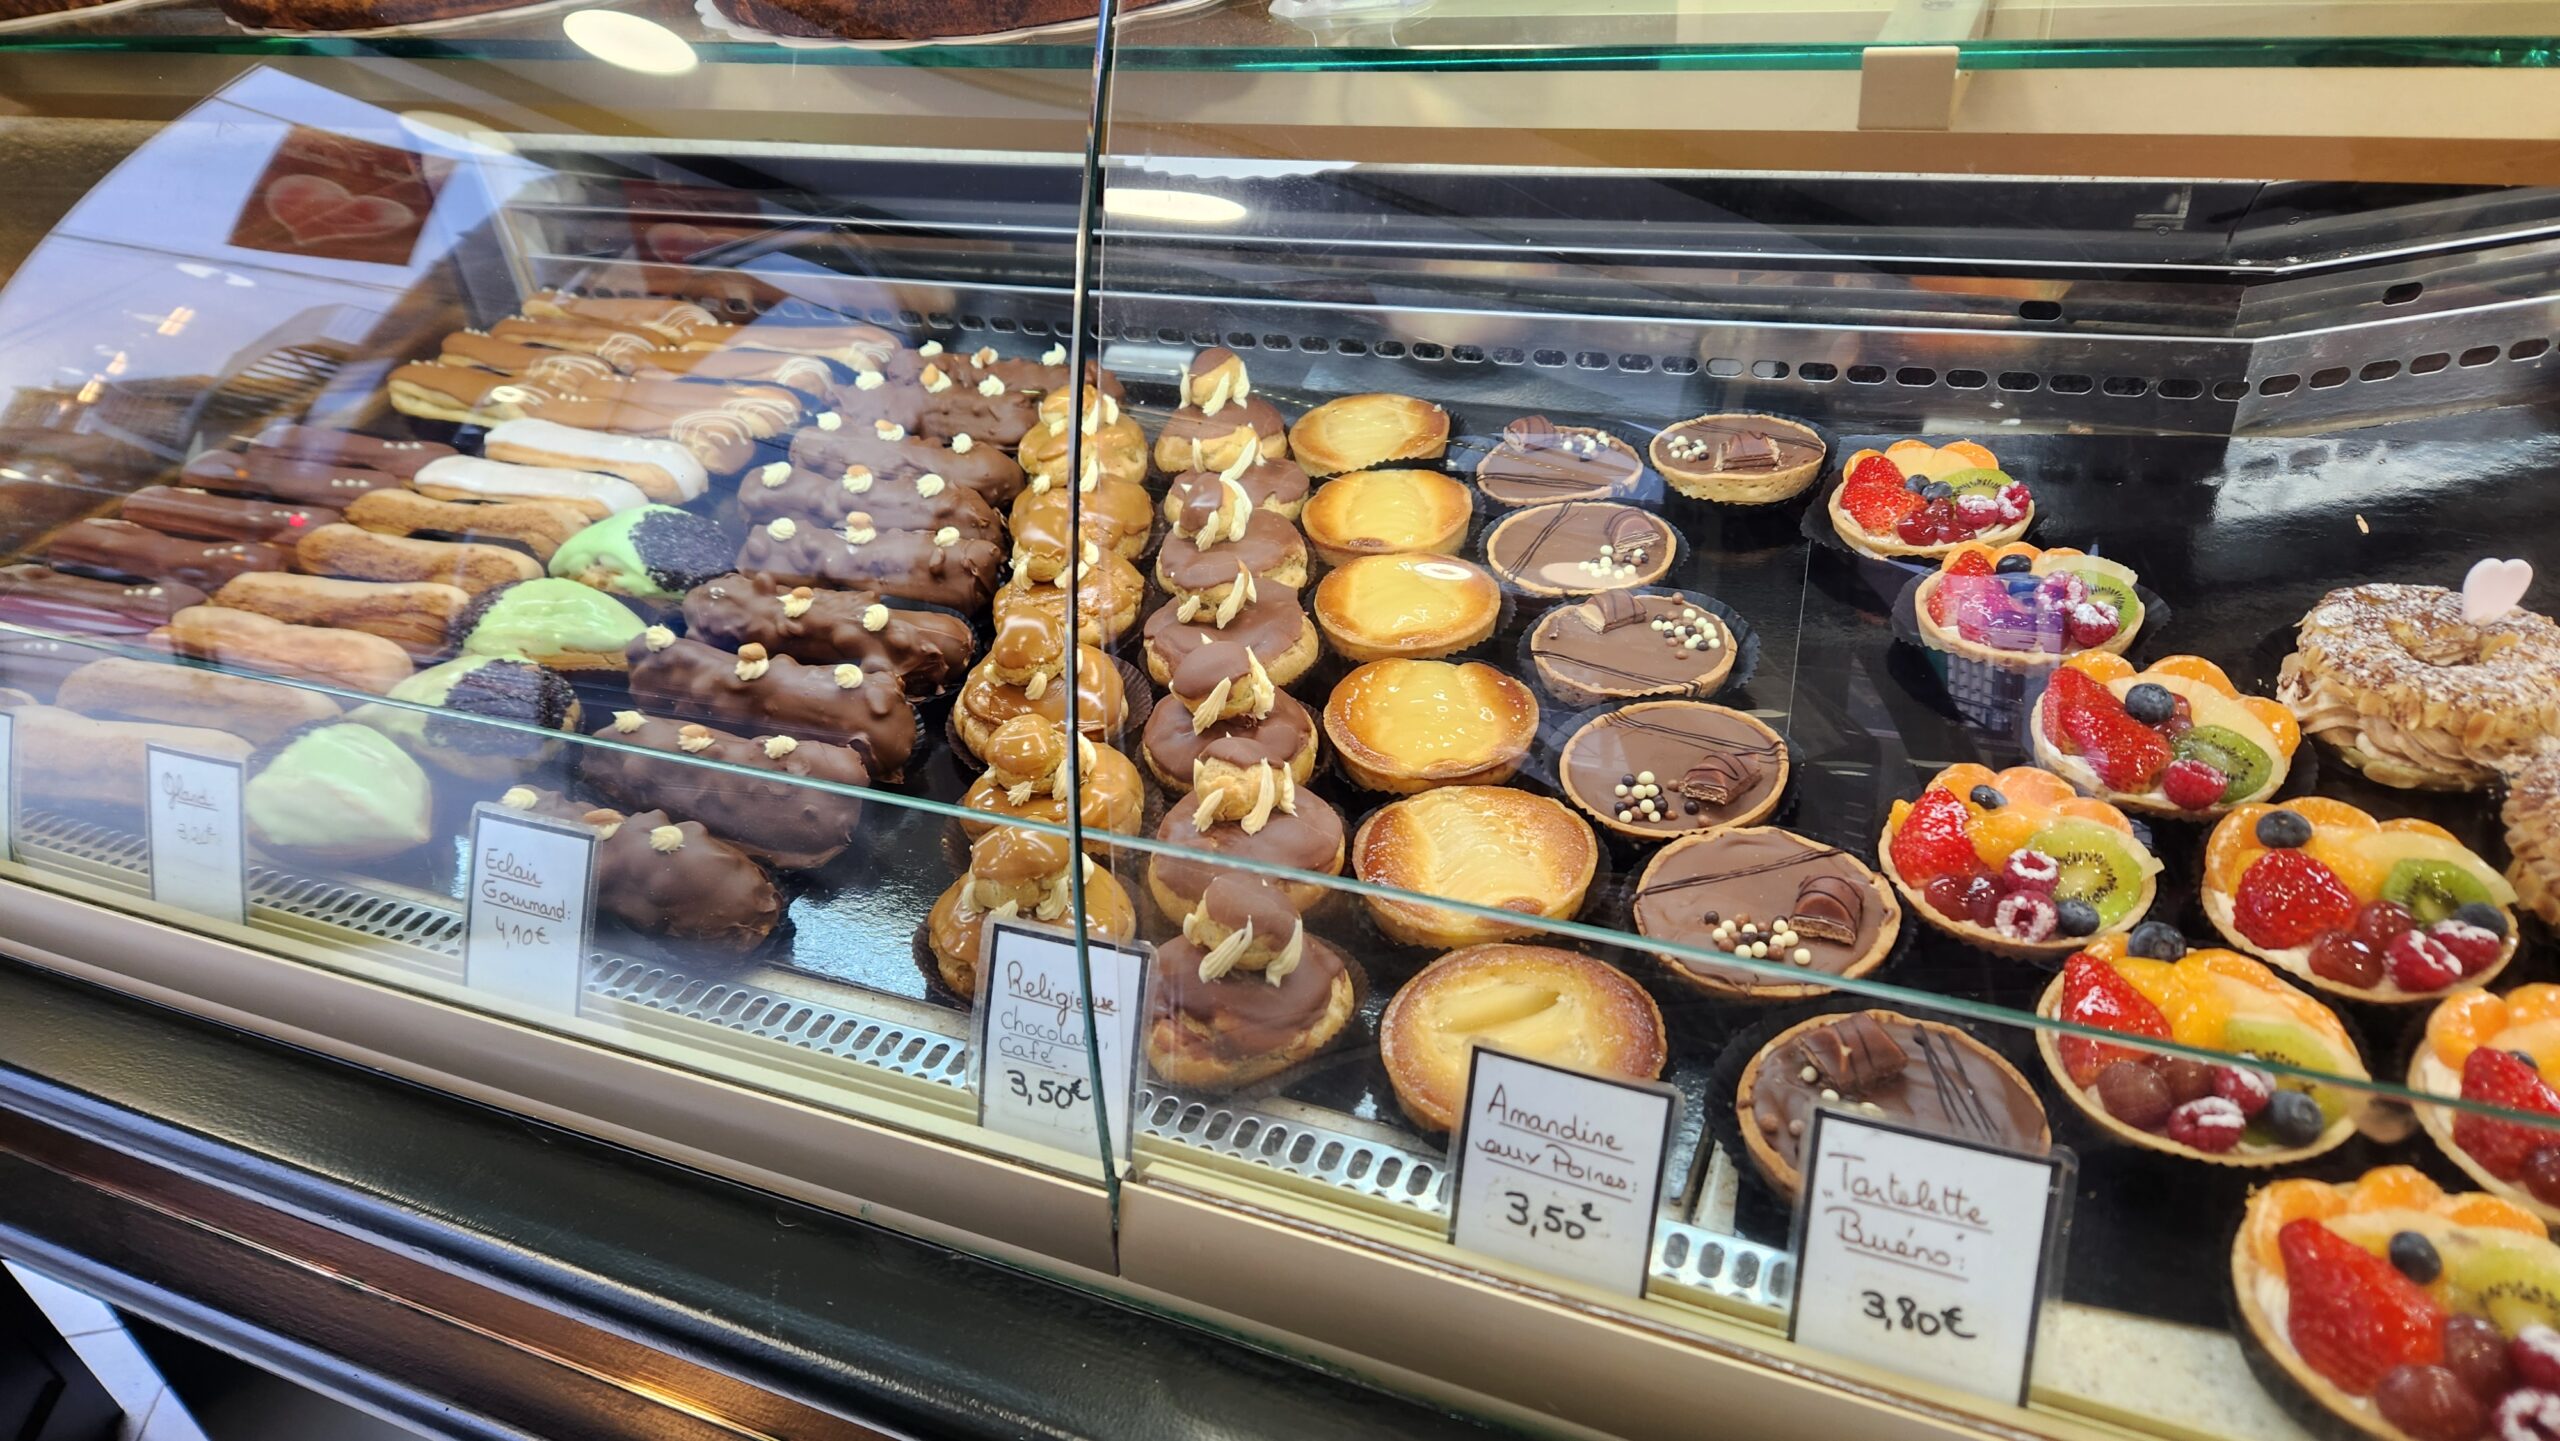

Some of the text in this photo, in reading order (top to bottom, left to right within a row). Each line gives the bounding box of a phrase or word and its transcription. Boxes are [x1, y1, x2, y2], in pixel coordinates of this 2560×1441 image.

[485, 848, 543, 885] Eclair
[481, 880, 571, 920] Gourmand:
[495, 915, 550, 950] 4,10€
[1006, 1068, 1092, 1109] 3,50€
[1487, 1083, 1624, 1151] Amandine
[1475, 1139, 1541, 1166] aux
[1827, 1152, 1990, 1226] Tartelette
[1861, 1289, 1977, 1339] 3,80€
